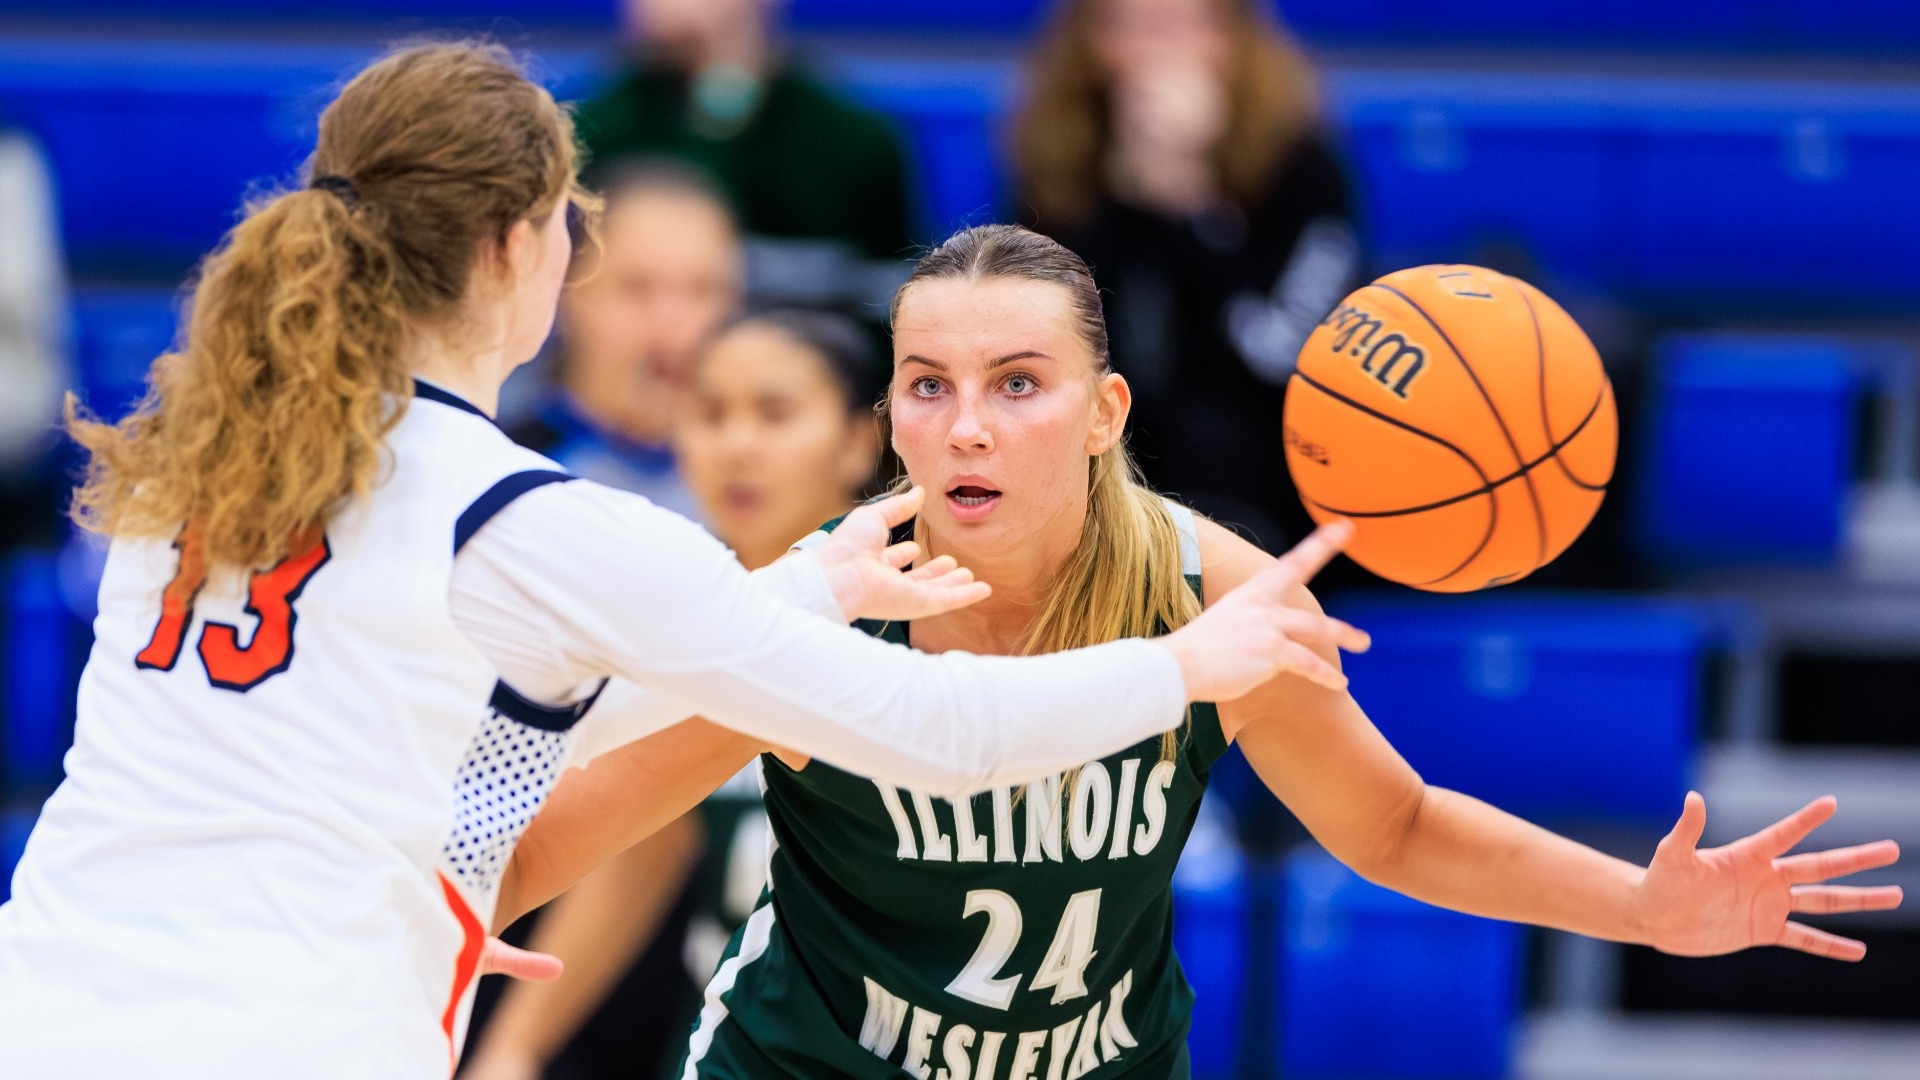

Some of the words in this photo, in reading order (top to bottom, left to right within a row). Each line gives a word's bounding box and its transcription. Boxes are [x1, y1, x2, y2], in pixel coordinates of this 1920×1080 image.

[134, 521, 332, 693] 13
[871, 758, 1177, 865] ILLINOIS
[943, 887, 1103, 1011] 24
